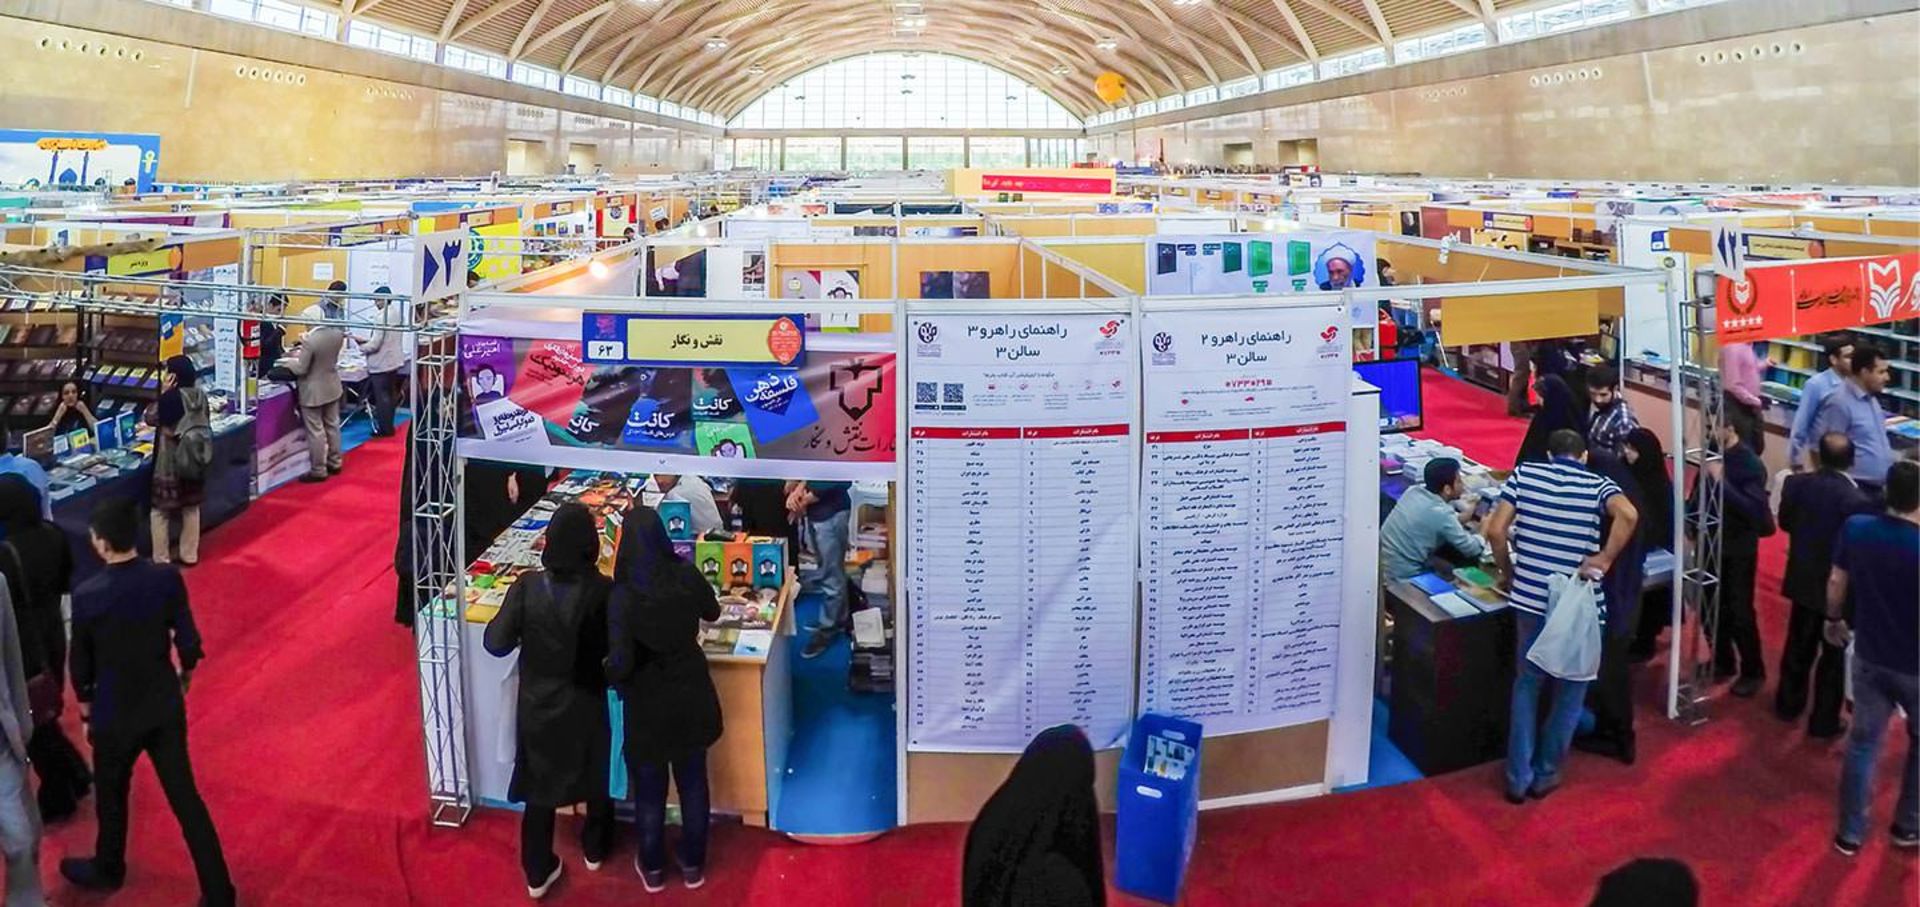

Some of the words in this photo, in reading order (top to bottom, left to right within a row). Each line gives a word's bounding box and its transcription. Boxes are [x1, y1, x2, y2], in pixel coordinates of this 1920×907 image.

[1728, 231, 1737, 270] ۲
[443, 239, 461, 287] ۳
[968, 326, 979, 335] ۳
[981, 324, 1016, 339] راهرو
[1018, 324, 1067, 338] راهنمای
[671, 334, 690, 349] نگار
[693, 339, 698, 349] و
[700, 336, 723, 348] نقش
[1201, 335, 1207, 344] ۲
[1212, 332, 1244, 346] راهرو
[1246, 331, 1291, 345] راهنمای
[597, 345, 613, 357] ۶۳
[996, 347, 1007, 357] ۳
[1007, 346, 1040, 360] سالن
[1226, 354, 1238, 364] ۳
[1238, 352, 1267, 365] سالن
[745, 373, 781, 402] ذهن
[760, 376, 798, 401] فلسفه
[692, 398, 733, 411] کانت
[627, 412, 675, 428] کانت
[804, 426, 825, 449] نگار
